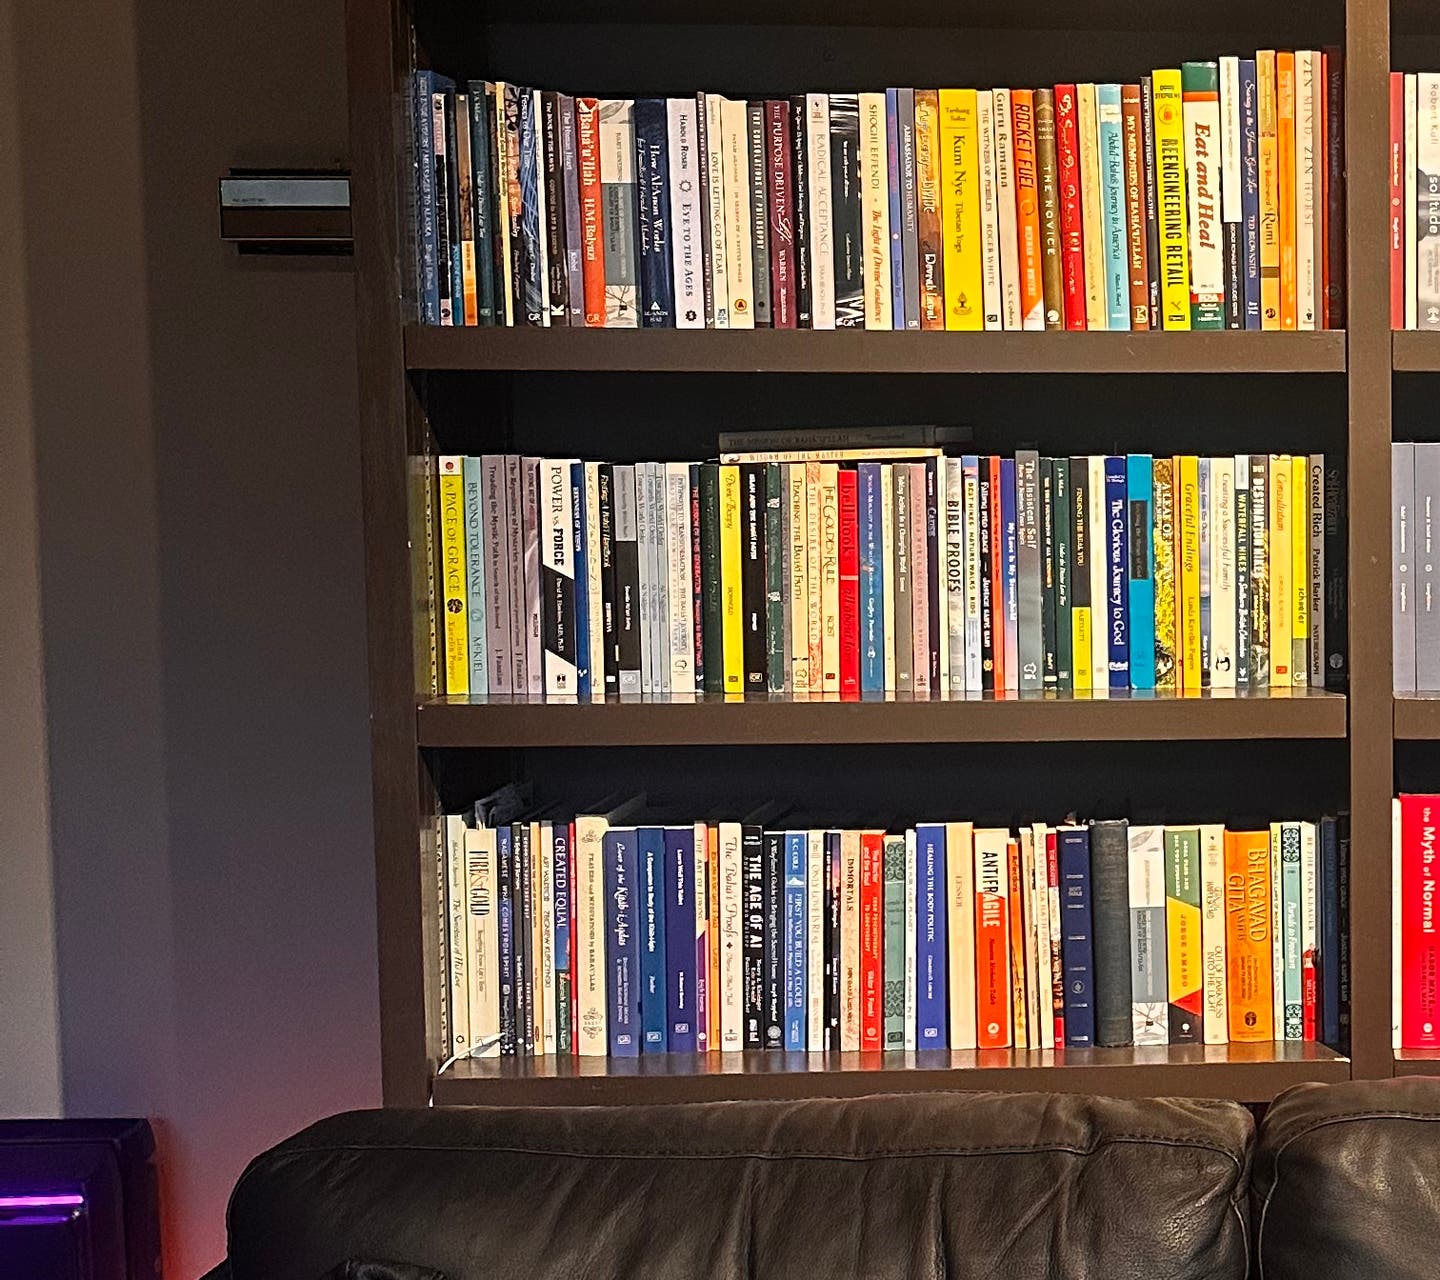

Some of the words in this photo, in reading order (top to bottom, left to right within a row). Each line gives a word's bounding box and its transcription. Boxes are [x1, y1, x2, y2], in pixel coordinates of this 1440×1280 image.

[996, 93, 1007, 129] Guru
[1016, 103, 1032, 155] ROCKET
[953, 135, 966, 165] Kum
[1195, 123, 1210, 157] Eat
[999, 133, 1009, 188] Ramana
[1018, 160, 1035, 190] FUEL
[952, 171, 967, 196] Nye
[1162, 138, 1181, 240] REENGINEERING
[1045, 201, 1055, 255] NOVICE
[1198, 202, 1214, 248] Heal
[1262, 212, 1276, 245] Rumi
[1166, 246, 1184, 288] RETAIL
[447, 481, 454, 489] A
[550, 466, 564, 513] POWER
[1311, 465, 1322, 508] Created
[445, 492, 460, 524] PACE
[468, 482, 479, 528] BEYOND
[947, 500, 960, 536] BIBLE
[1112, 500, 1122, 518] The
[1183, 483, 1196, 528] Graceful
[448, 528, 458, 542] OF
[1112, 519, 1123, 563] Glorious
[1312, 512, 1322, 538] Rich
[470, 531, 482, 598] TOLERANCE
[552, 528, 566, 566] FORCE
[1183, 532, 1197, 572] Endings
[1312, 549, 1321, 580] Patrick
[447, 546, 461, 592] GRACE
[947, 542, 961, 592] PROOFS
[1109, 567, 1124, 605] Journey
[1312, 584, 1321, 612] Barker
[1113, 608, 1123, 618] to
[1113, 622, 1124, 645] God
[1424, 808, 1432, 822] the
[556, 837, 567, 889] CREATED
[1422, 826, 1436, 863] Myth
[750, 886, 762, 911] AGE
[983, 852, 1001, 927] ANTIFRAGILE
[1228, 873, 1245, 912] GITA
[1423, 880, 1436, 933] Normal
[557, 892, 568, 928] EQUAL
[751, 915, 763, 934] OF
[751, 938, 763, 948] AI
